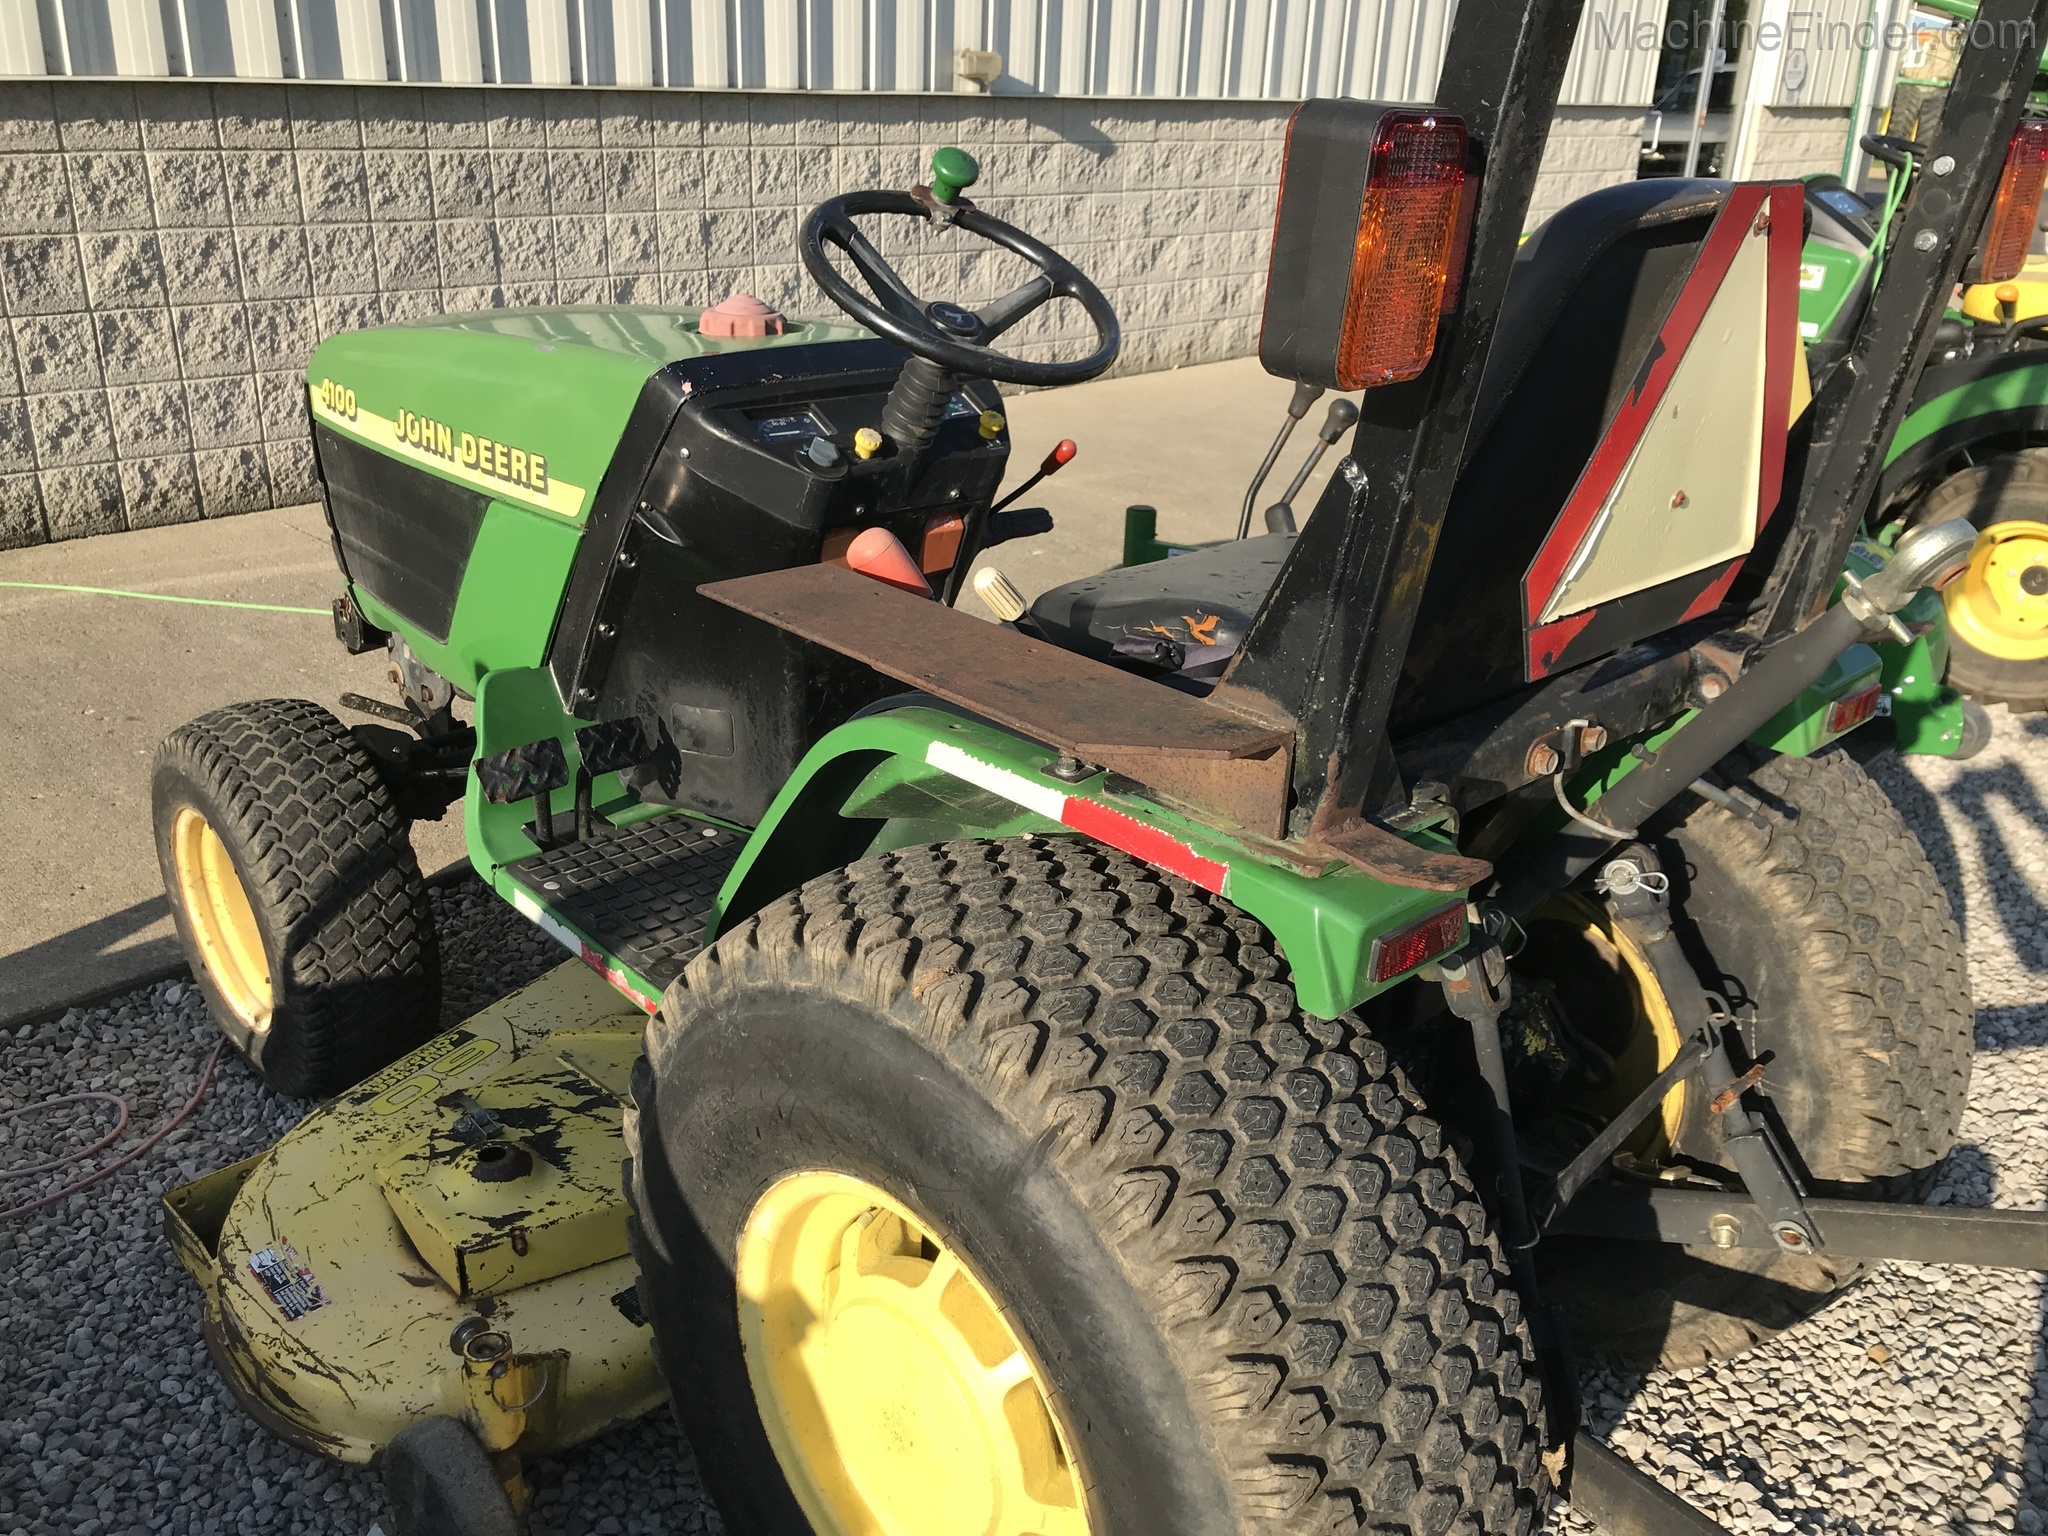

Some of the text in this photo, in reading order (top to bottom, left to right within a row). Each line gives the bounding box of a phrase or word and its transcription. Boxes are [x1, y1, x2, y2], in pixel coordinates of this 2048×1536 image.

[320, 377, 357, 421] 4100
[393, 406, 549, 496] JOHN DEERE
